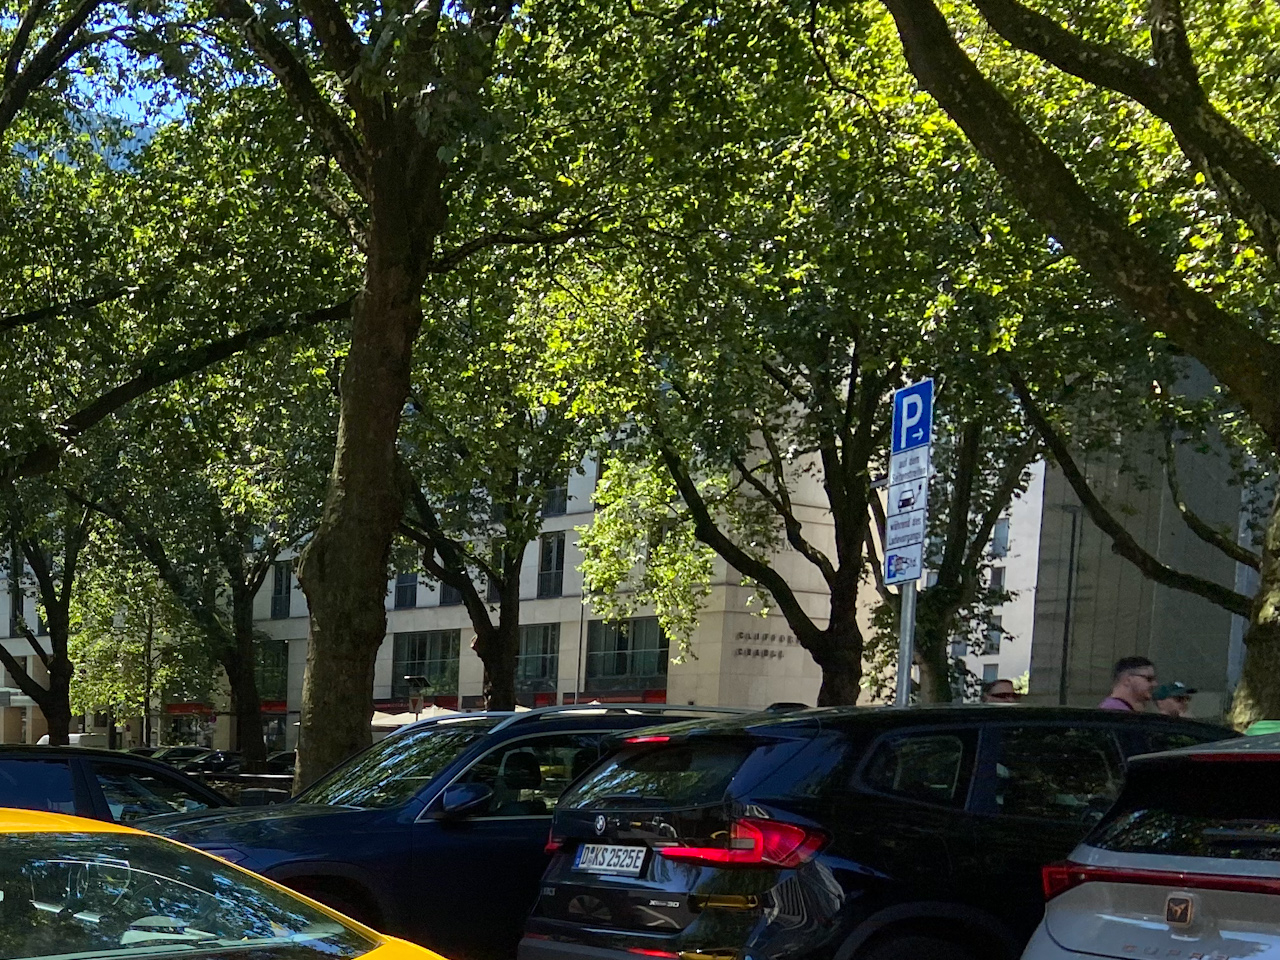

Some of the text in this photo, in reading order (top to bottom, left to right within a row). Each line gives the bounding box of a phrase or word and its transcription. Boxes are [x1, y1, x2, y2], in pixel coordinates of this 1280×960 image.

[901, 394, 923, 449] P
[592, 847, 609, 867] KS
[606, 848, 644, 869] 2525E
